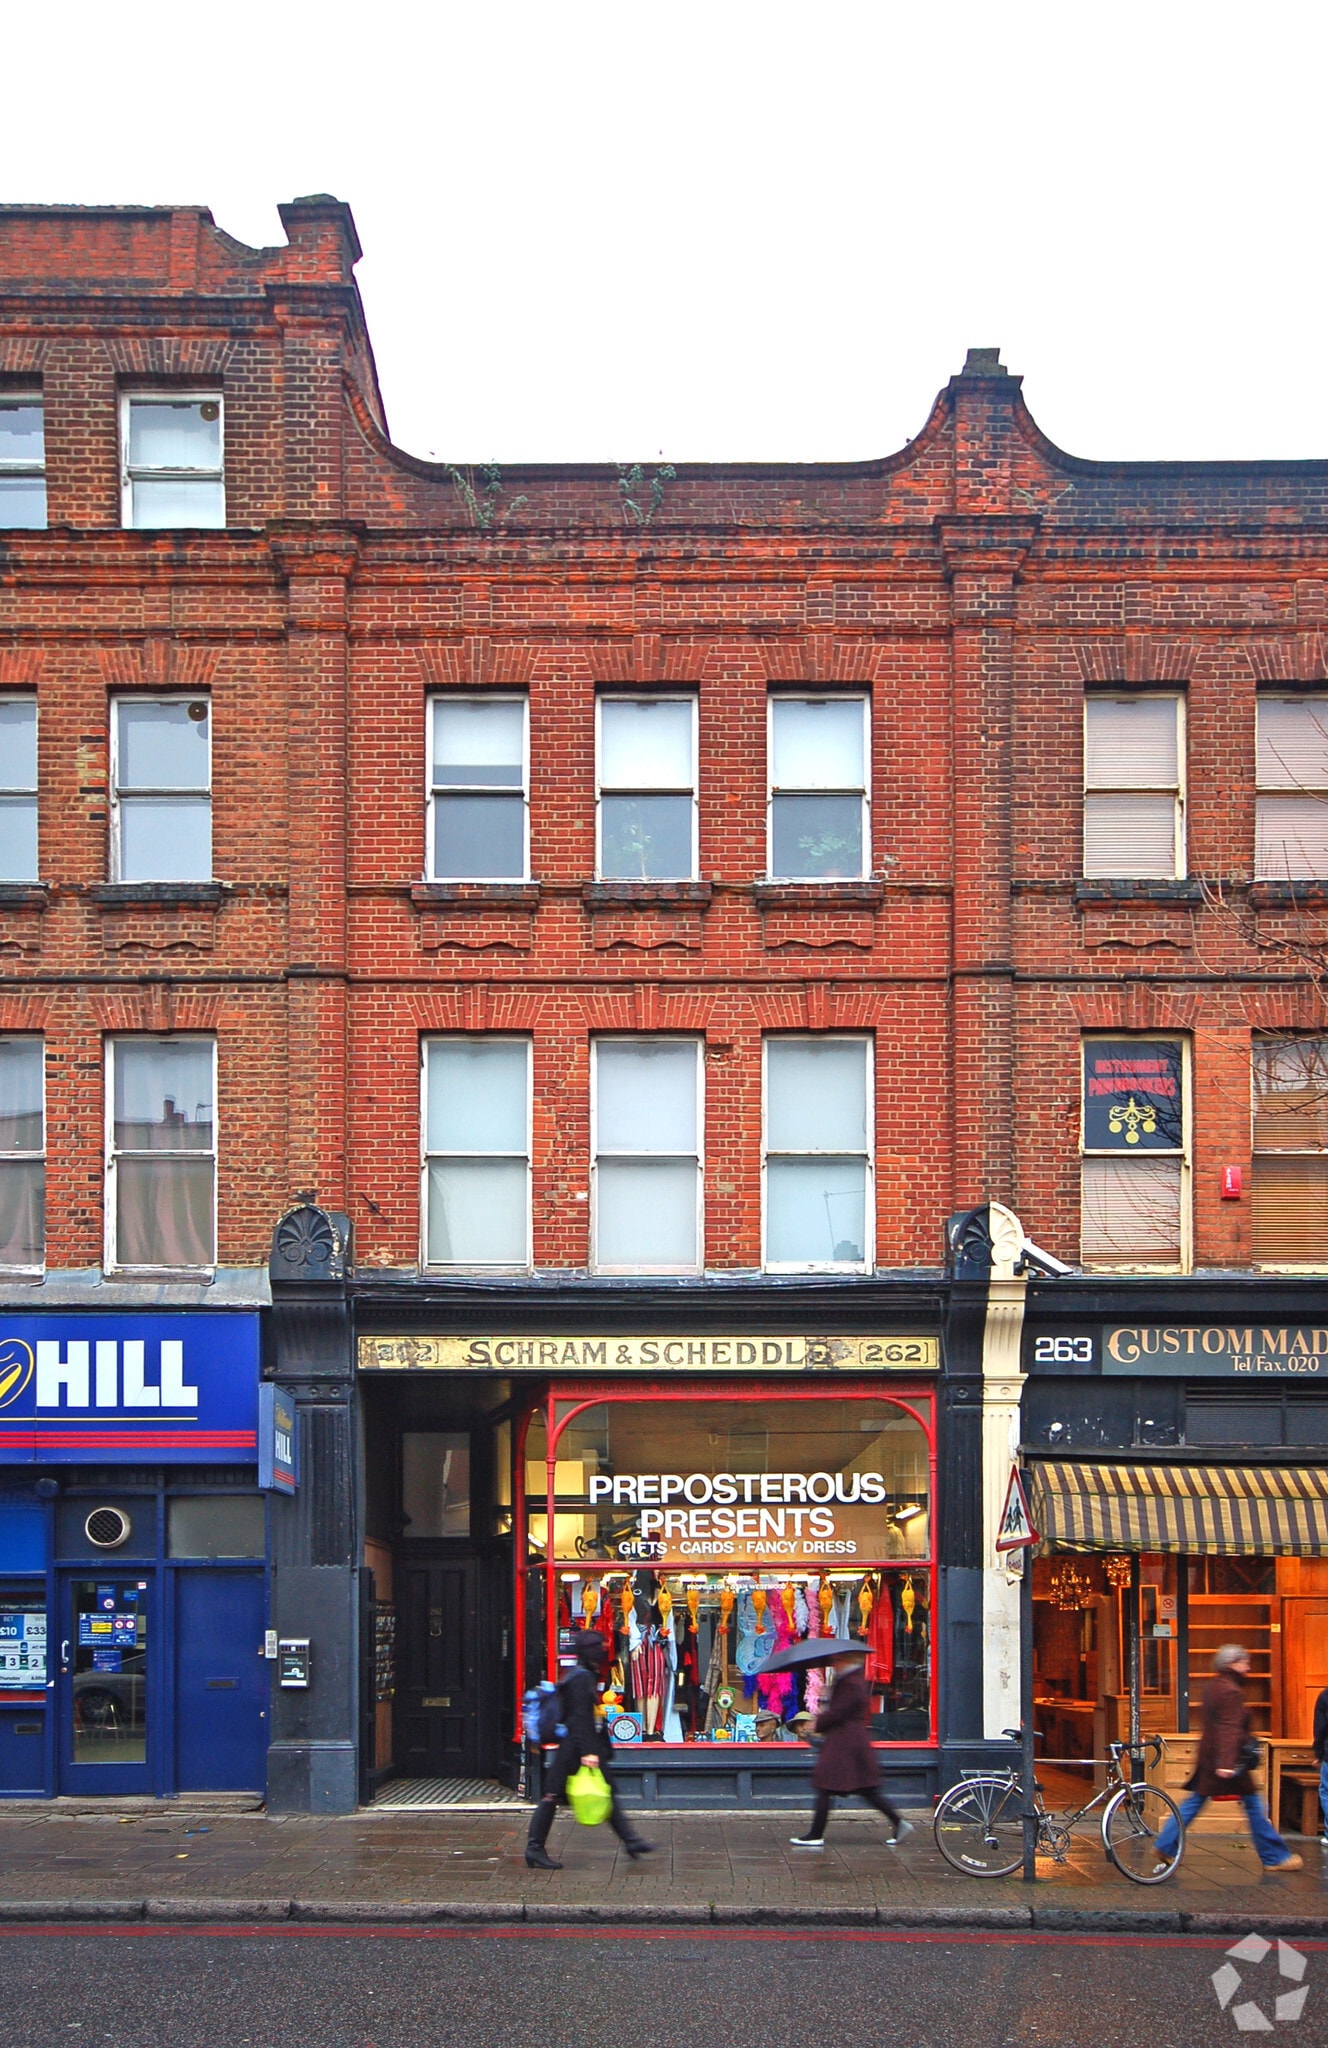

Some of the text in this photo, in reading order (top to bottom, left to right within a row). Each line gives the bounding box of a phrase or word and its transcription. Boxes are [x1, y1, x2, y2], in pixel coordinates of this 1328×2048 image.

[468, 1340, 607, 1365] SCHRAM
[616, 1344, 632, 1364] &
[1034, 1336, 1093, 1362] 263
[1107, 1328, 1254, 1363] CUSTOM
[36, 1340, 198, 1407] HILL
[1288, 1356, 1319, 1372] 020
[275, 1430, 292, 1465] HILL
[589, 1472, 886, 1505] PREPOSTEROUS
[640, 1507, 834, 1539] PRESENTS
[618, 1540, 857, 1555] GIFTS CARDS FANCY DRESS
[0, 1627, 46, 1636] £10 £33
[10, 1658, 39, 1667] 3 2
